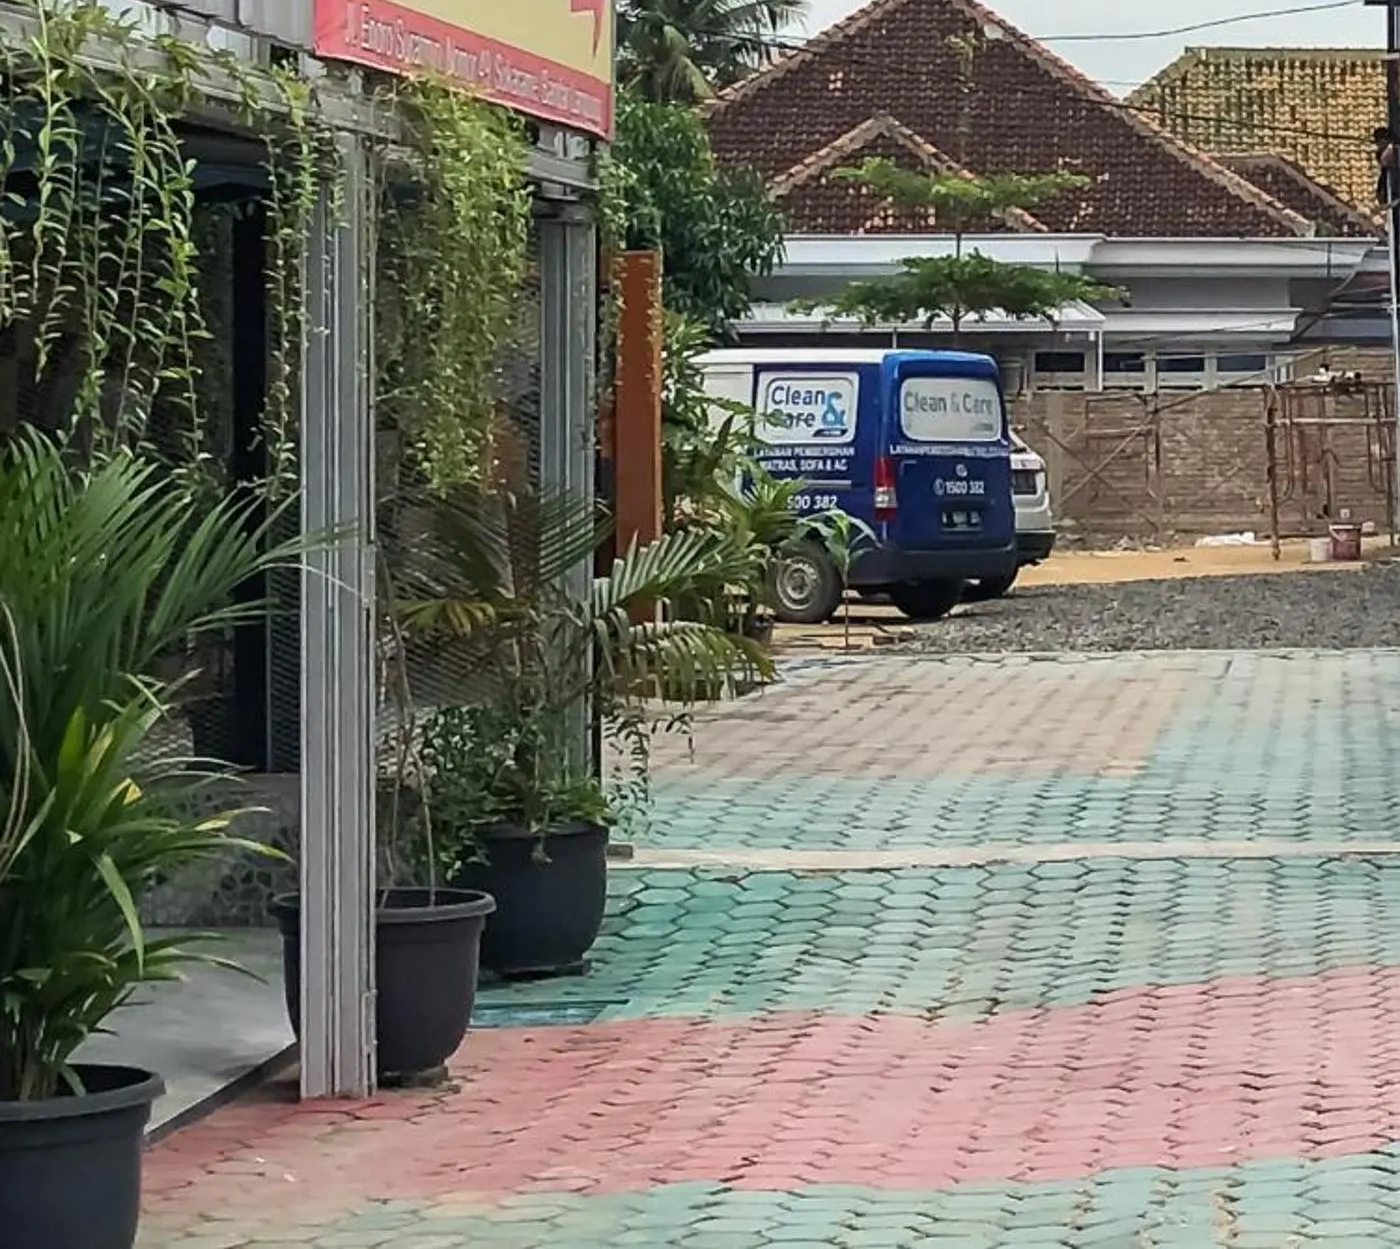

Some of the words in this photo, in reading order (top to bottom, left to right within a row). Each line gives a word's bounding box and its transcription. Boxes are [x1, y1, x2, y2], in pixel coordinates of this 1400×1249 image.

[770, 385, 826, 406] Clean
[904, 390, 948, 413] Clean
[963, 393, 994, 415] Care
[769, 409, 815, 428] are
[822, 391, 846, 427] &
[814, 495, 838, 509] 382
